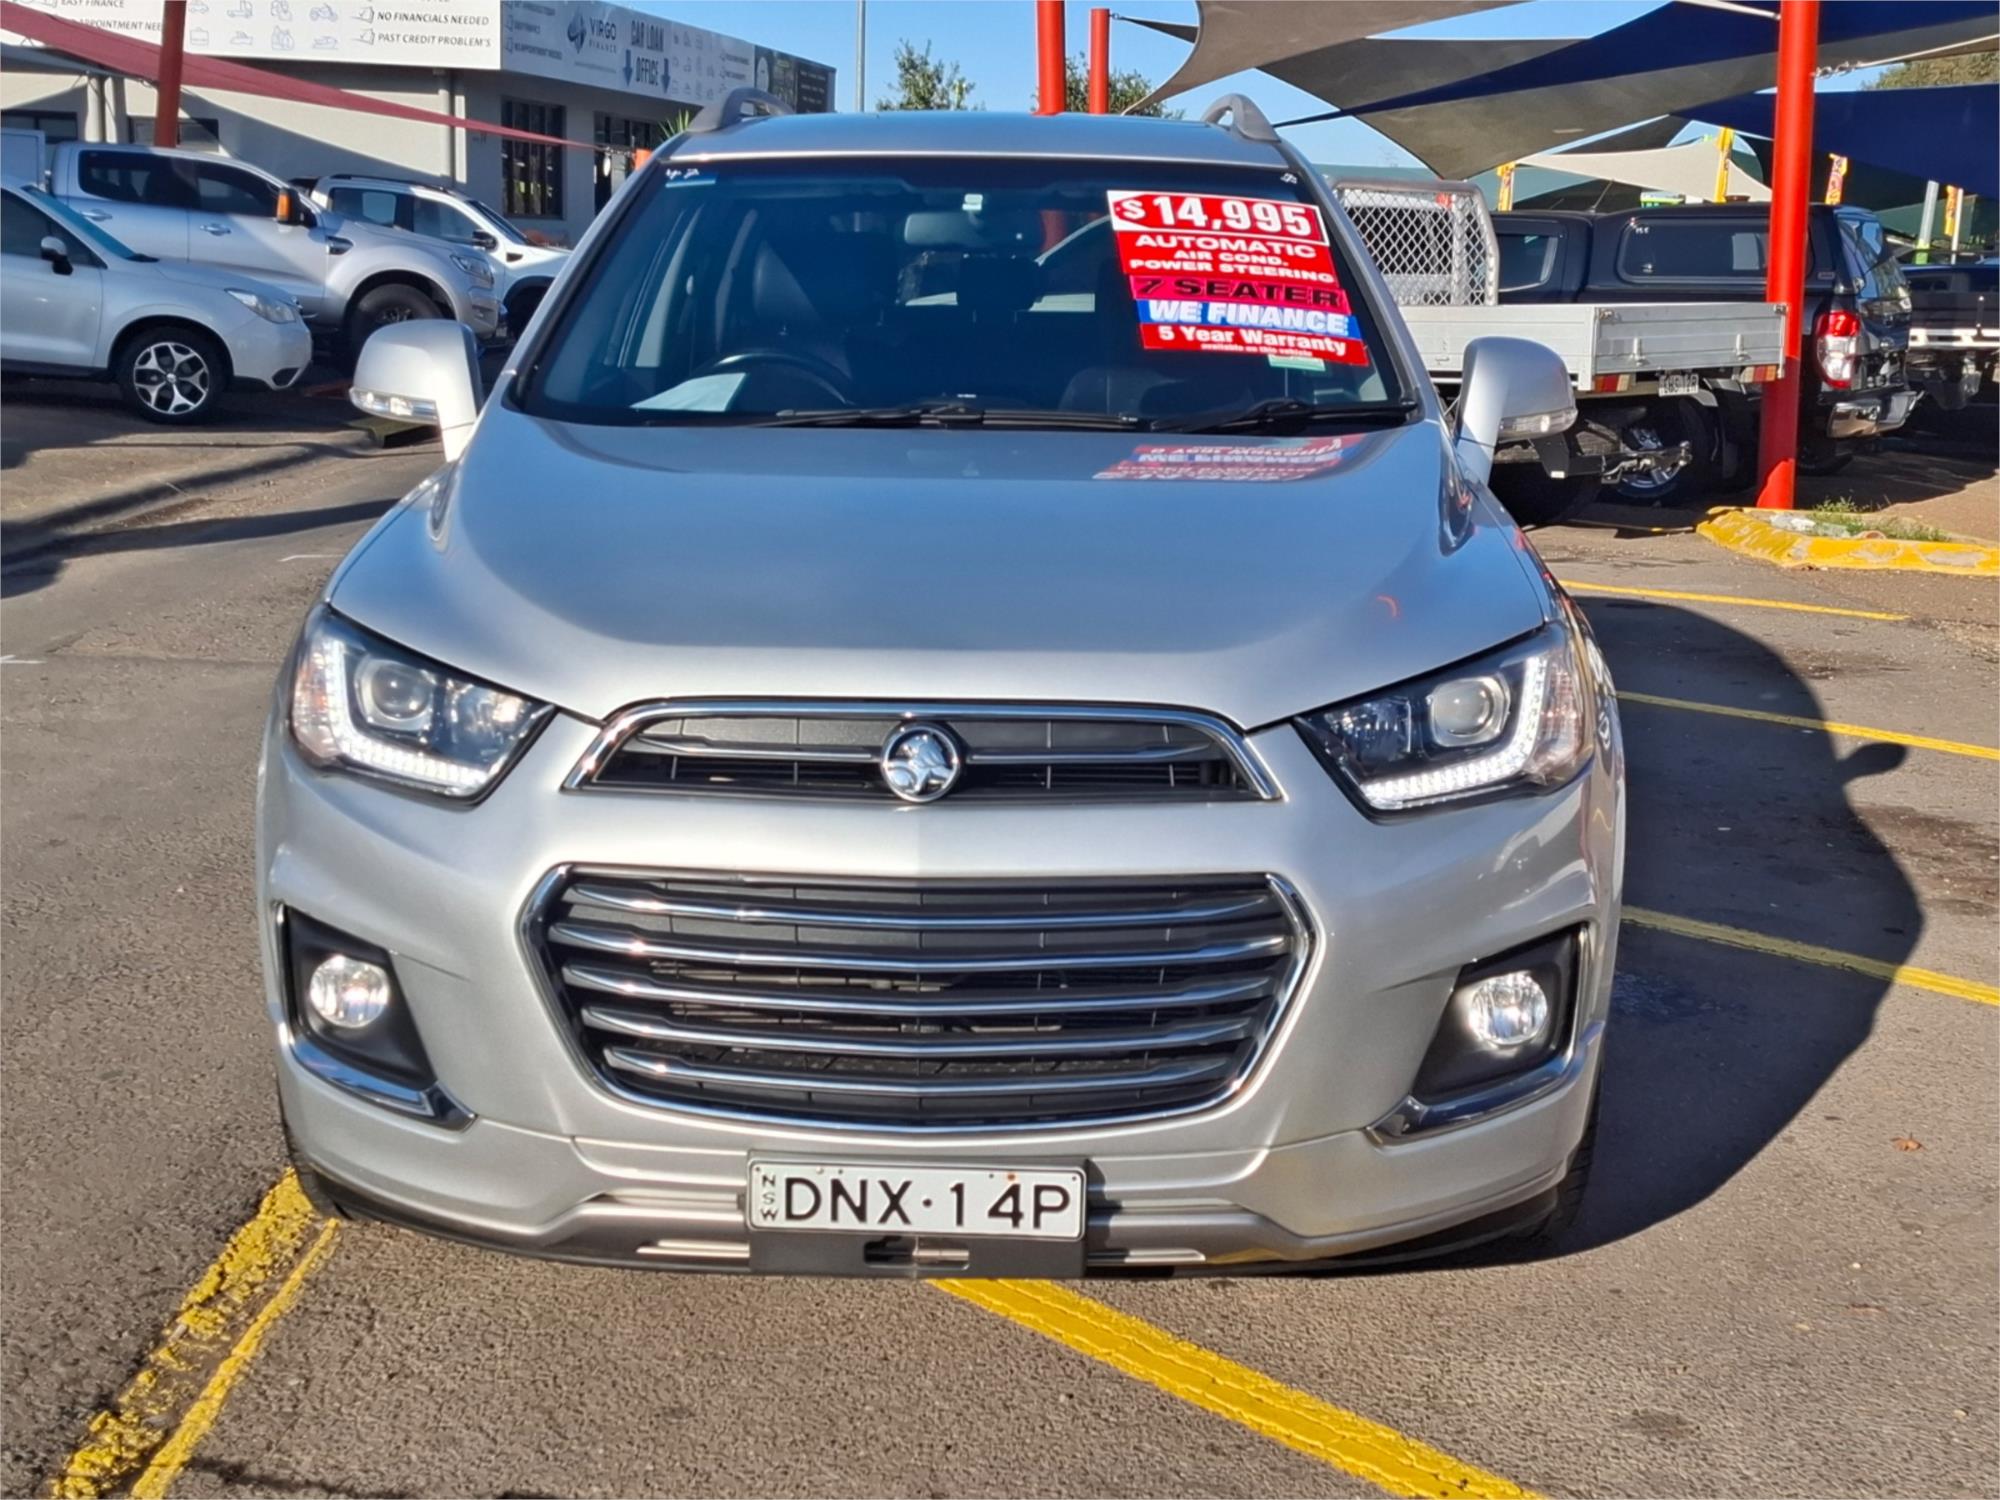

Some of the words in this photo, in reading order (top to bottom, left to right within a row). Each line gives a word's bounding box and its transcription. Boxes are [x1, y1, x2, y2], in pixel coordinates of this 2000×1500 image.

[85, 0, 125, 8] FINANCE
[144, 21, 162, 31] NEE
[377, 11, 392, 21] NO
[393, 12, 449, 24] FINANCIALS
[450, 15, 490, 26] NEEDED
[589, 17, 617, 41] VIRGO
[378, 32, 400, 42] PAST
[402, 33, 436, 44] CREDIT
[438, 35, 492, 48] PROBLEM'S
[631, 20, 645, 48] CAR
[646, 24, 664, 53] LOAN
[635, 56, 659, 86] OFFICE
[1135, 234, 1317, 258] AUTOMATIC
[1173, 250, 1213, 261] AIR
[1218, 252, 1289, 267] COND.
[1129, 259, 1213, 272] POWER
[1218, 263, 1335, 284] STEERING
[1136, 278, 1163, 295] 7
[1173, 279, 1341, 308] SEATER
[1149, 299, 1202, 323] WE
[1206, 302, 1349, 336] FINANCE
[1158, 325, 1175, 341] 5
[1180, 326, 1235, 343] Year
[1239, 328, 1346, 357] Warranty
[760, 1174, 778, 1222] NSW
